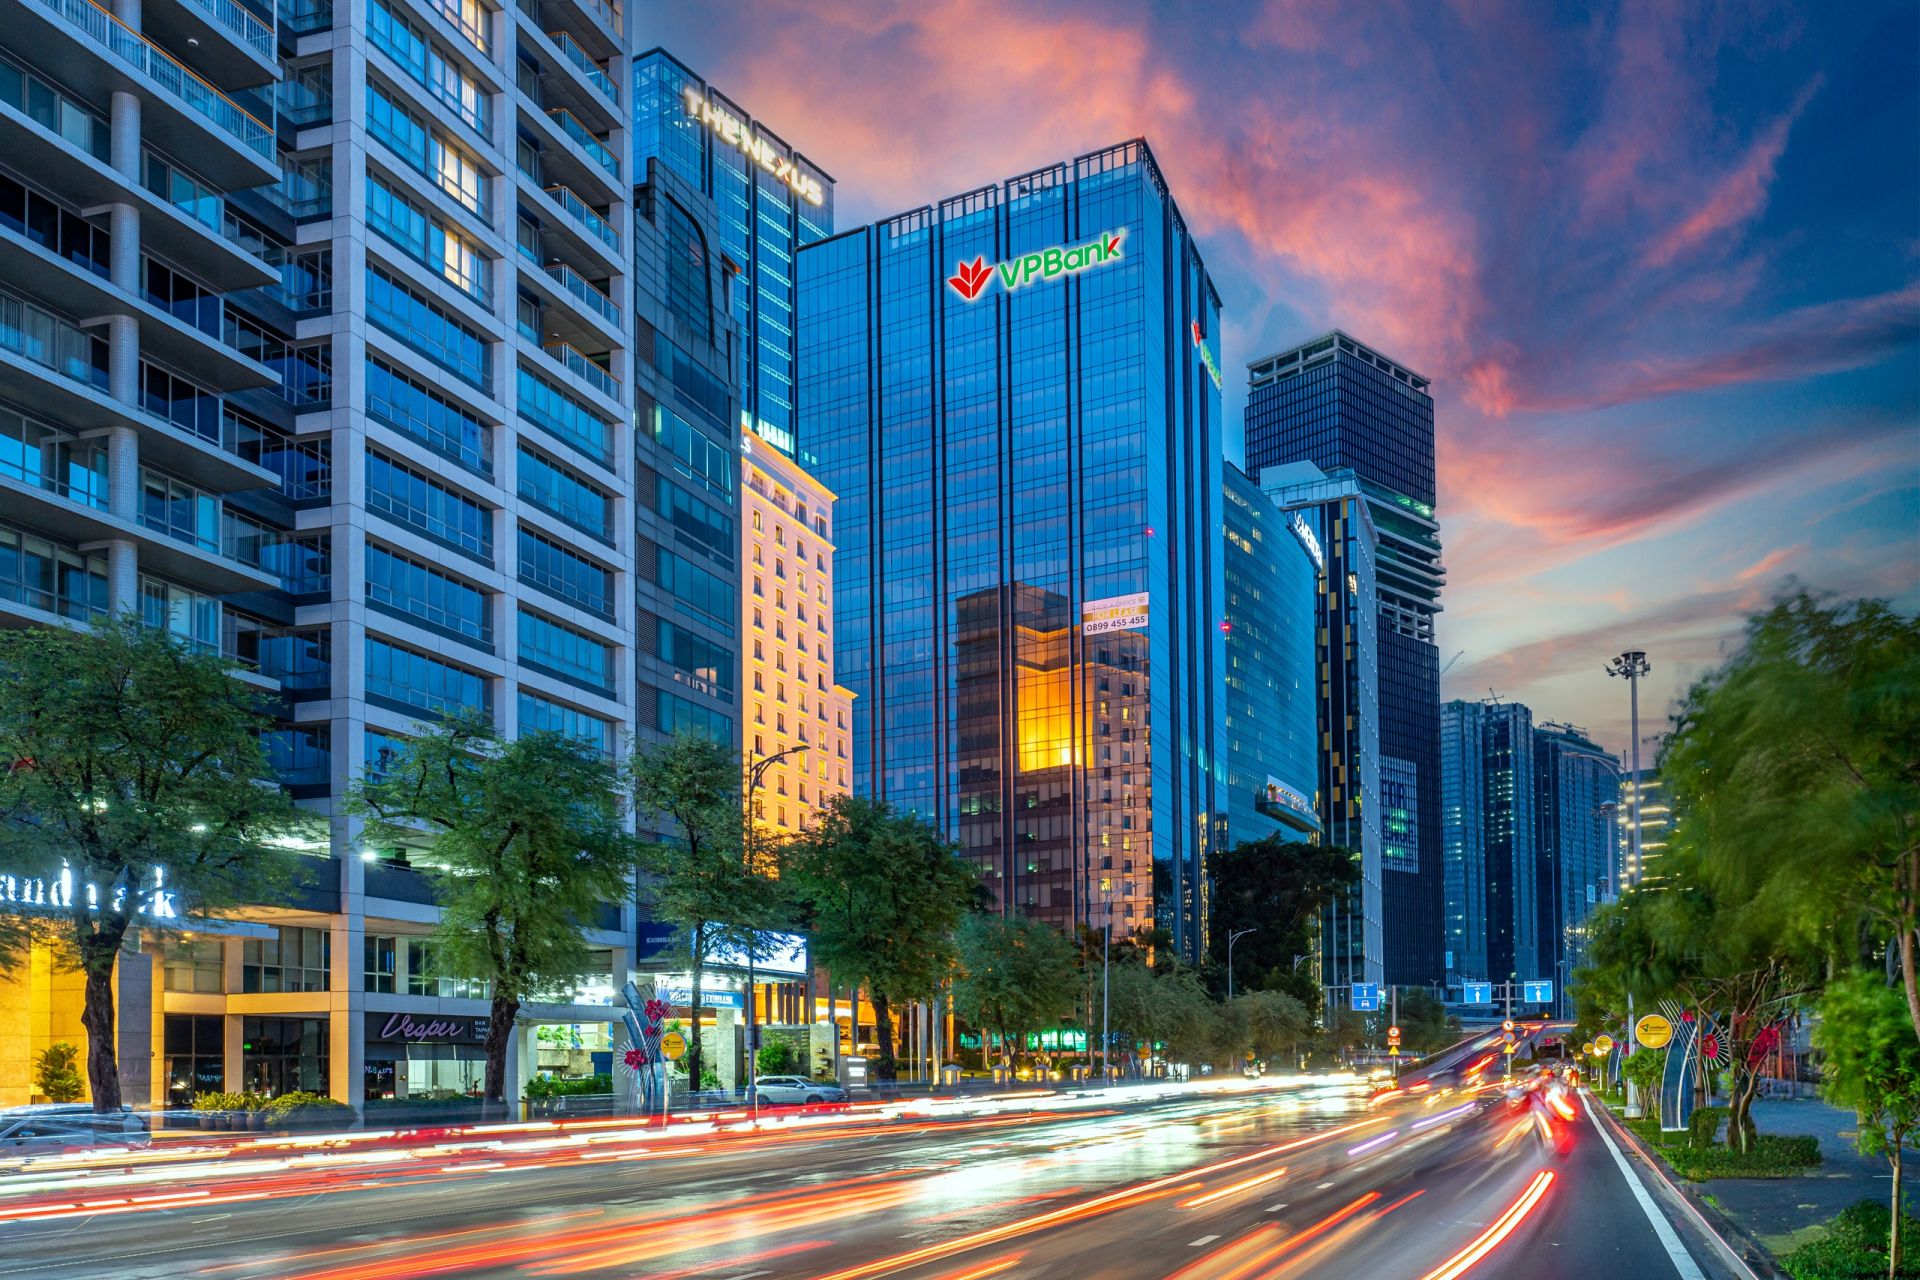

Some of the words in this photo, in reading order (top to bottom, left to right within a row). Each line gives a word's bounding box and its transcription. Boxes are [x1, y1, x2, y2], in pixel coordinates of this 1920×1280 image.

[1000, 233, 1121, 288] VPBank
[1087, 622, 1109, 632] 0899
[1111, 618, 1127, 628] 455
[1129, 615, 1145, 624] 455
[382, 1013, 463, 1042] Vesper
